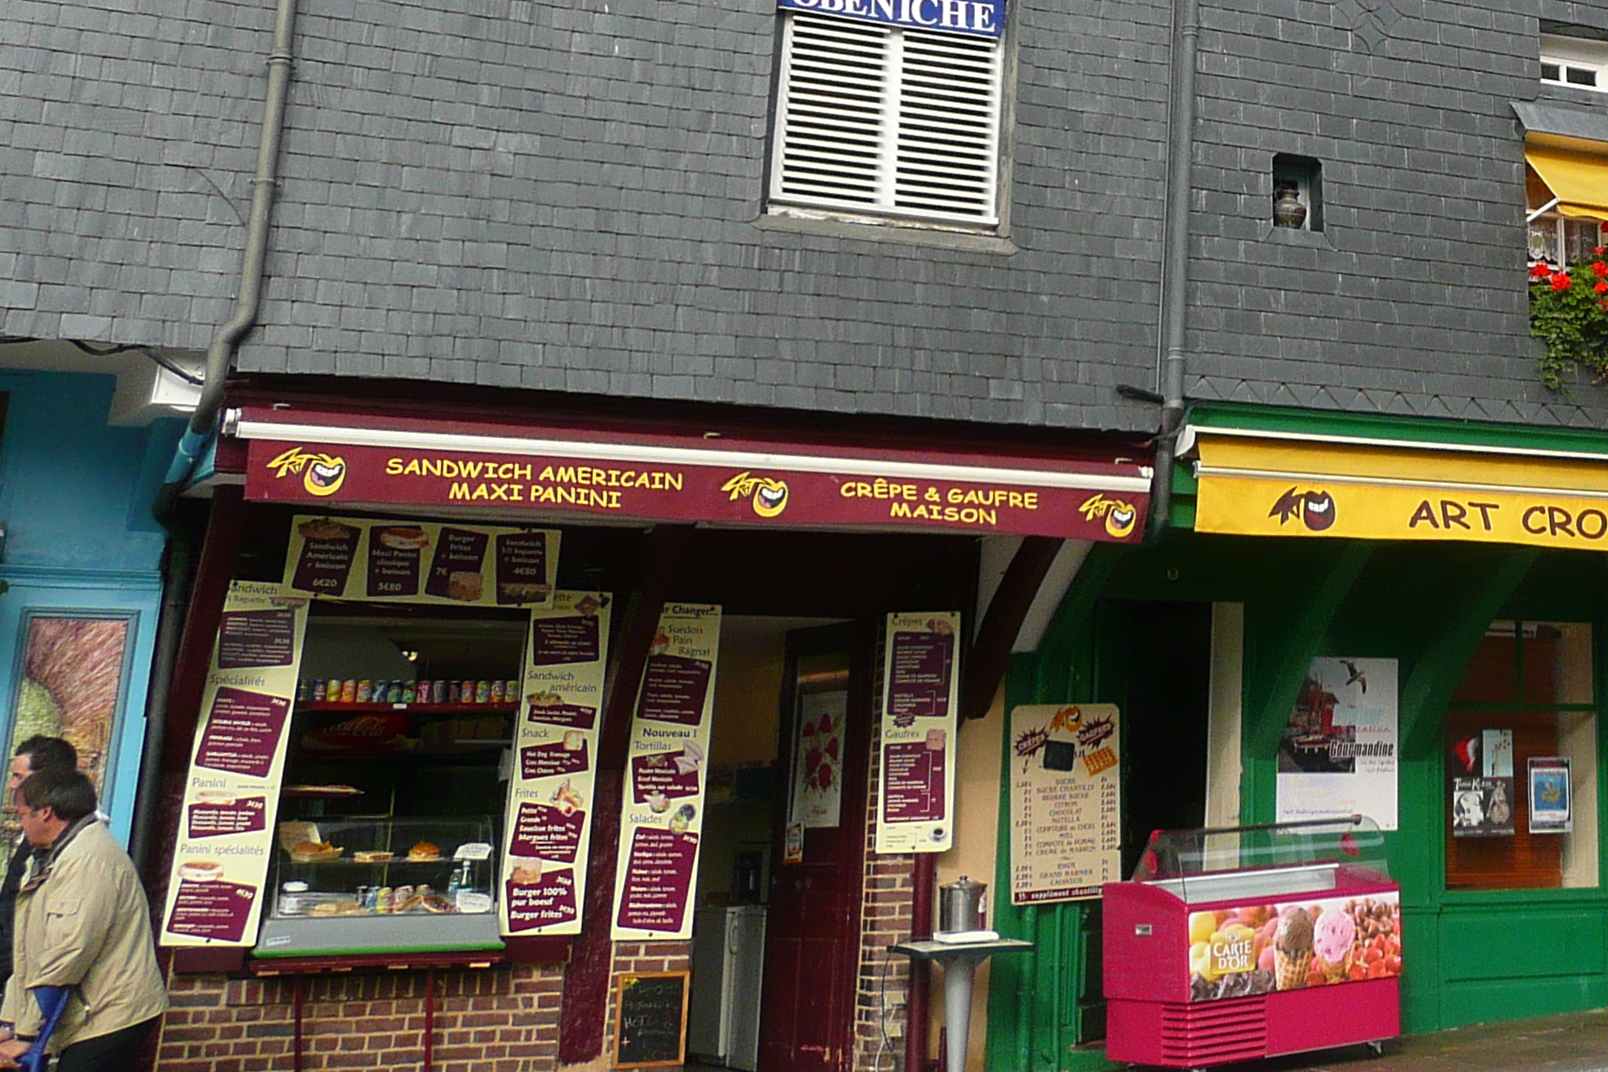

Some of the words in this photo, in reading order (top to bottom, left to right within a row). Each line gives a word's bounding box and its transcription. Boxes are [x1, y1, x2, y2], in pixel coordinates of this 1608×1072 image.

[385, 457, 532, 481] SANDWICH
[539, 465, 683, 490] AMERICAIN
[449, 482, 523, 502] MAXI
[529, 484, 622, 508] PANINI
[840, 477, 918, 501] CRÊPE
[924, 486, 941, 503] &
[946, 487, 1038, 510] GAUFRE
[890, 501, 997, 526] MAISON
[1408, 499, 1500, 531] ART
[230, 583, 278, 595] andwich
[673, 635, 693, 644] Pain
[528, 670, 574, 681] Sandwich
[522, 728, 549, 738] Snack
[642, 727, 690, 738] Nouveau
[635, 740, 672, 751] Tortillas
[1330, 740, 1394, 757] Gourmandine
[192, 777, 227, 788] Panini
[515, 787, 538, 798] Frites
[629, 813, 662, 824] Salades
[180, 843, 211, 854] Panini
[1213, 939, 1253, 958] CARTE
[1218, 955, 1249, 970] D'OR
